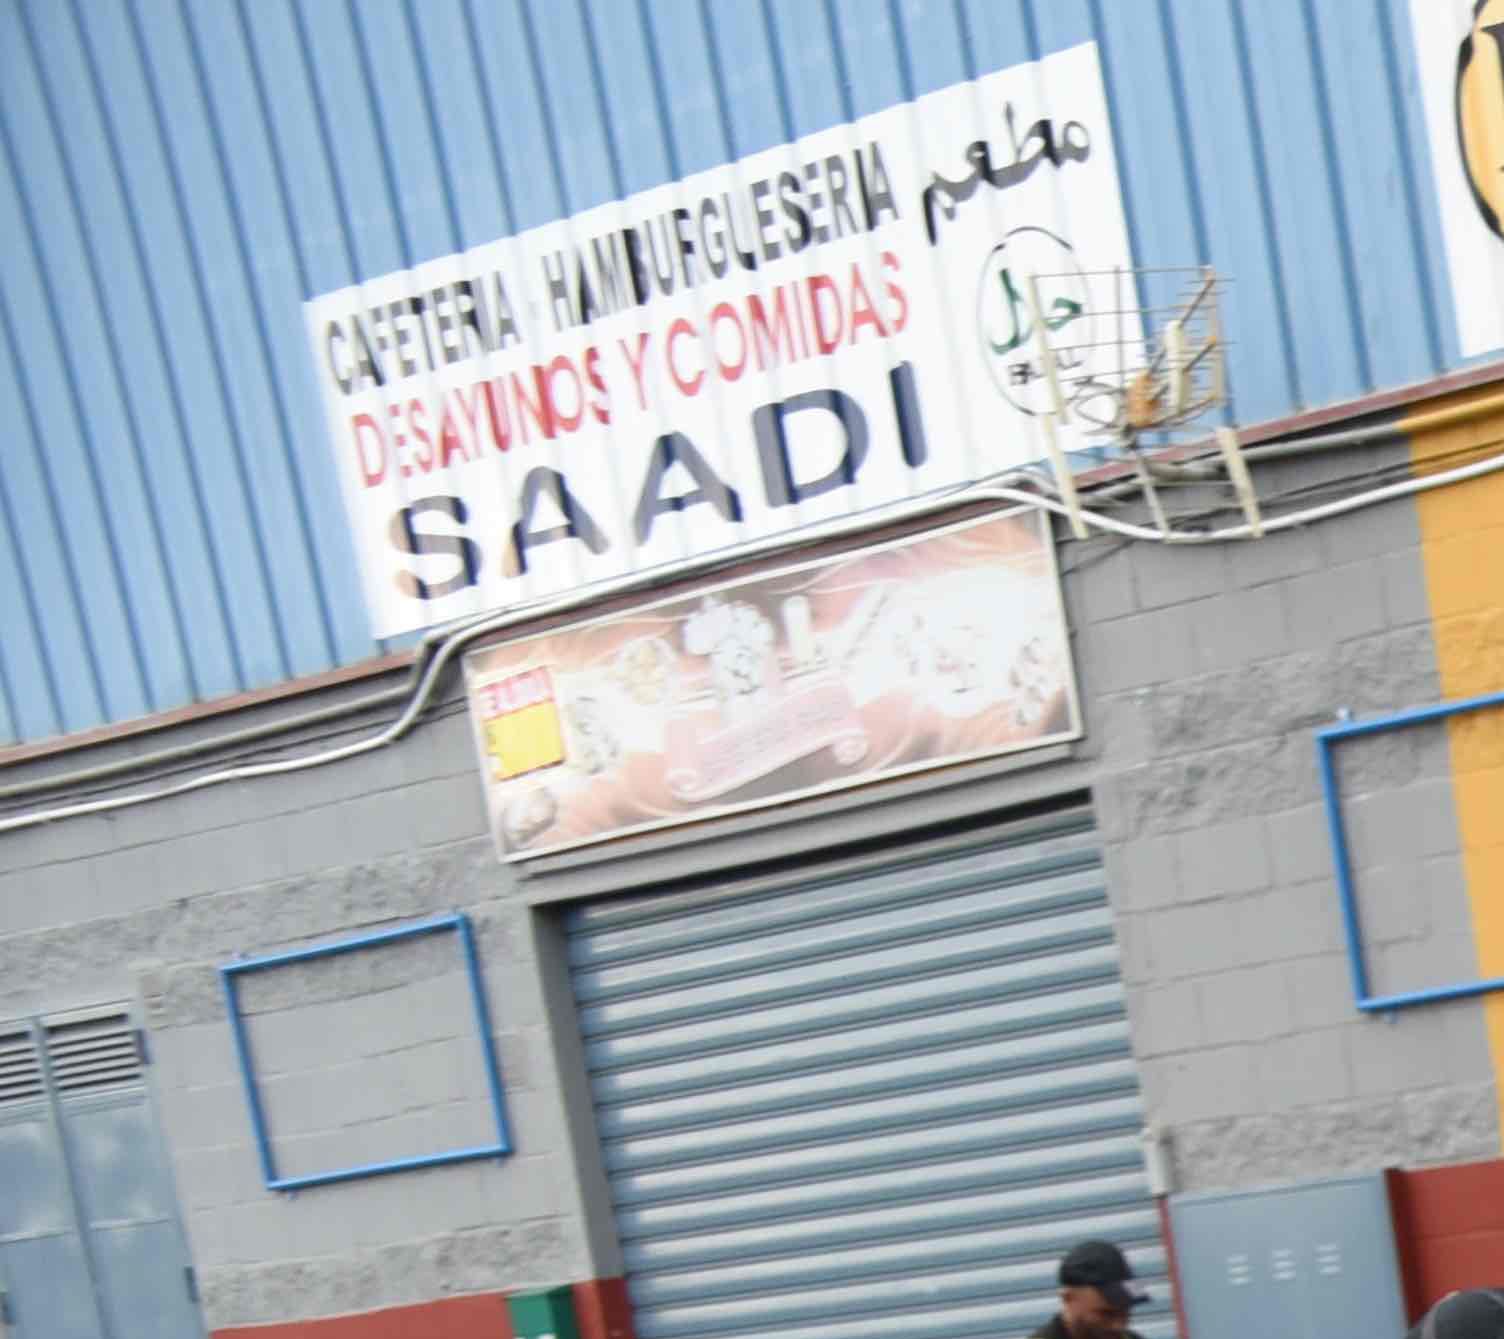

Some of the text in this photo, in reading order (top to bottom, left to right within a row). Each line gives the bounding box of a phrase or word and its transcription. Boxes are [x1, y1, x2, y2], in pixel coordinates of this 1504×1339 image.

[324, 270, 521, 396] CAFETERIA
[351, 250, 911, 488] DESAYUNOS Y COMIDAS
[387, 360, 930, 602] SAADI
